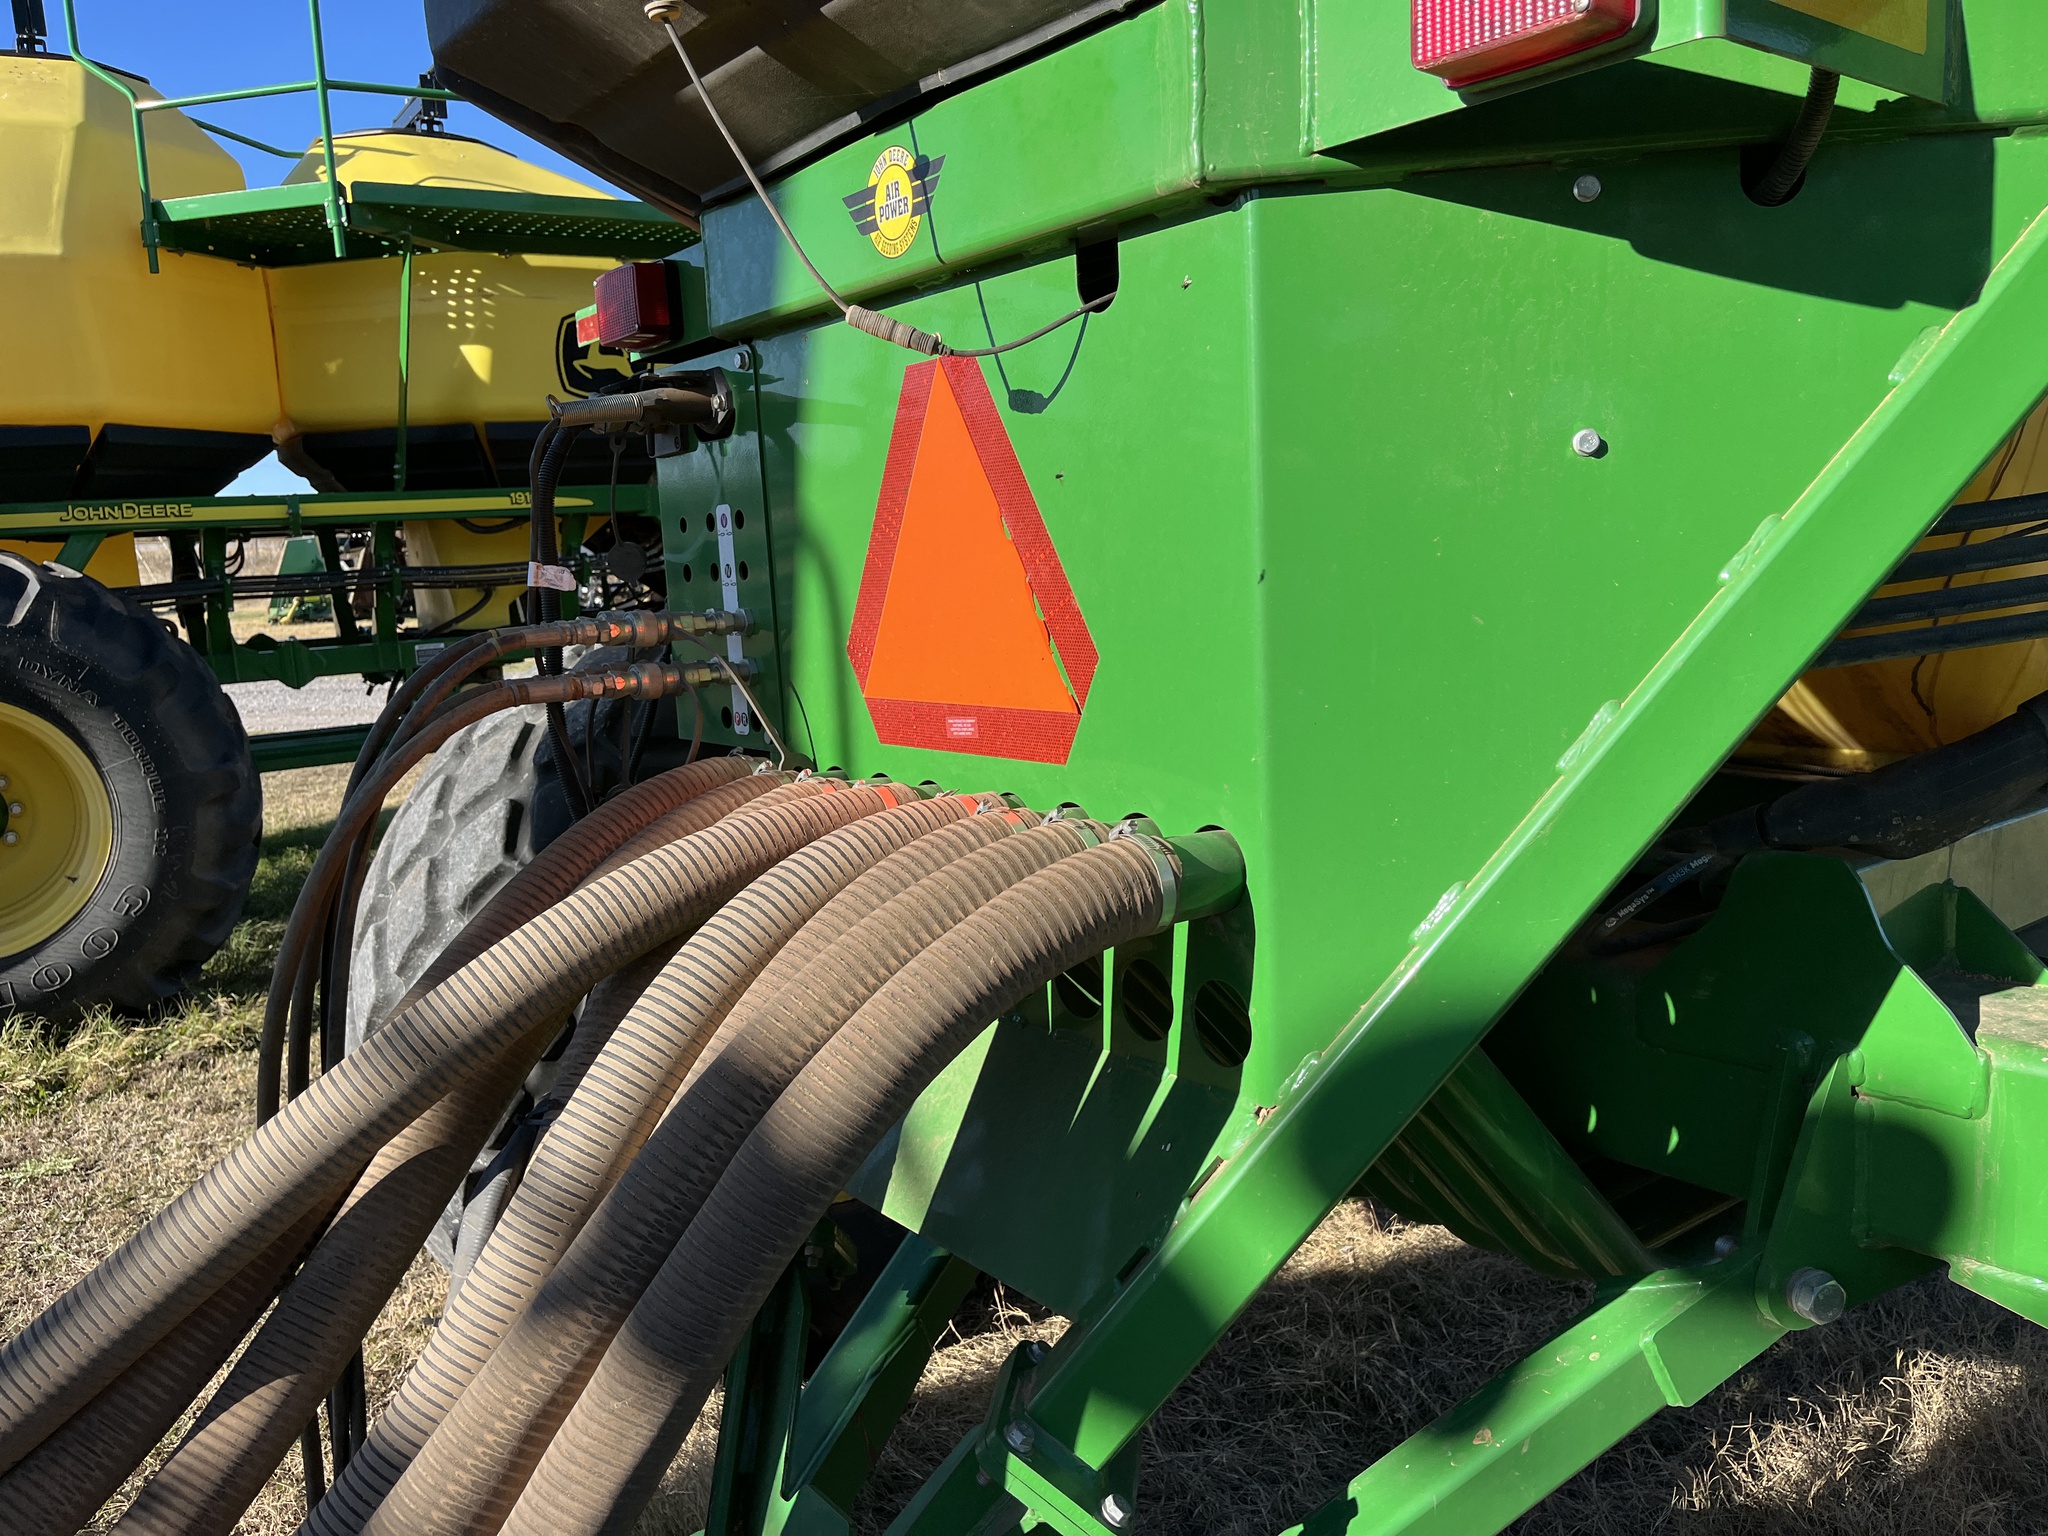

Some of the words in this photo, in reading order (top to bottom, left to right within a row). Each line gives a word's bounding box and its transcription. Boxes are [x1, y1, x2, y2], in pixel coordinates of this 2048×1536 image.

[873, 153, 888, 179] JOHN
[888, 148, 909, 167] DEERE
[885, 181, 900, 201] AIR
[879, 196, 909, 223] POWER
[899, 219, 918, 253] SYSTEMS
[510, 491, 532, 505] 191
[18, 656, 100, 708] DYNA
[113, 712, 167, 814] TORQUE
[1667, 865, 1692, 883] 6M3K
[1689, 853, 1715, 869] Mega
